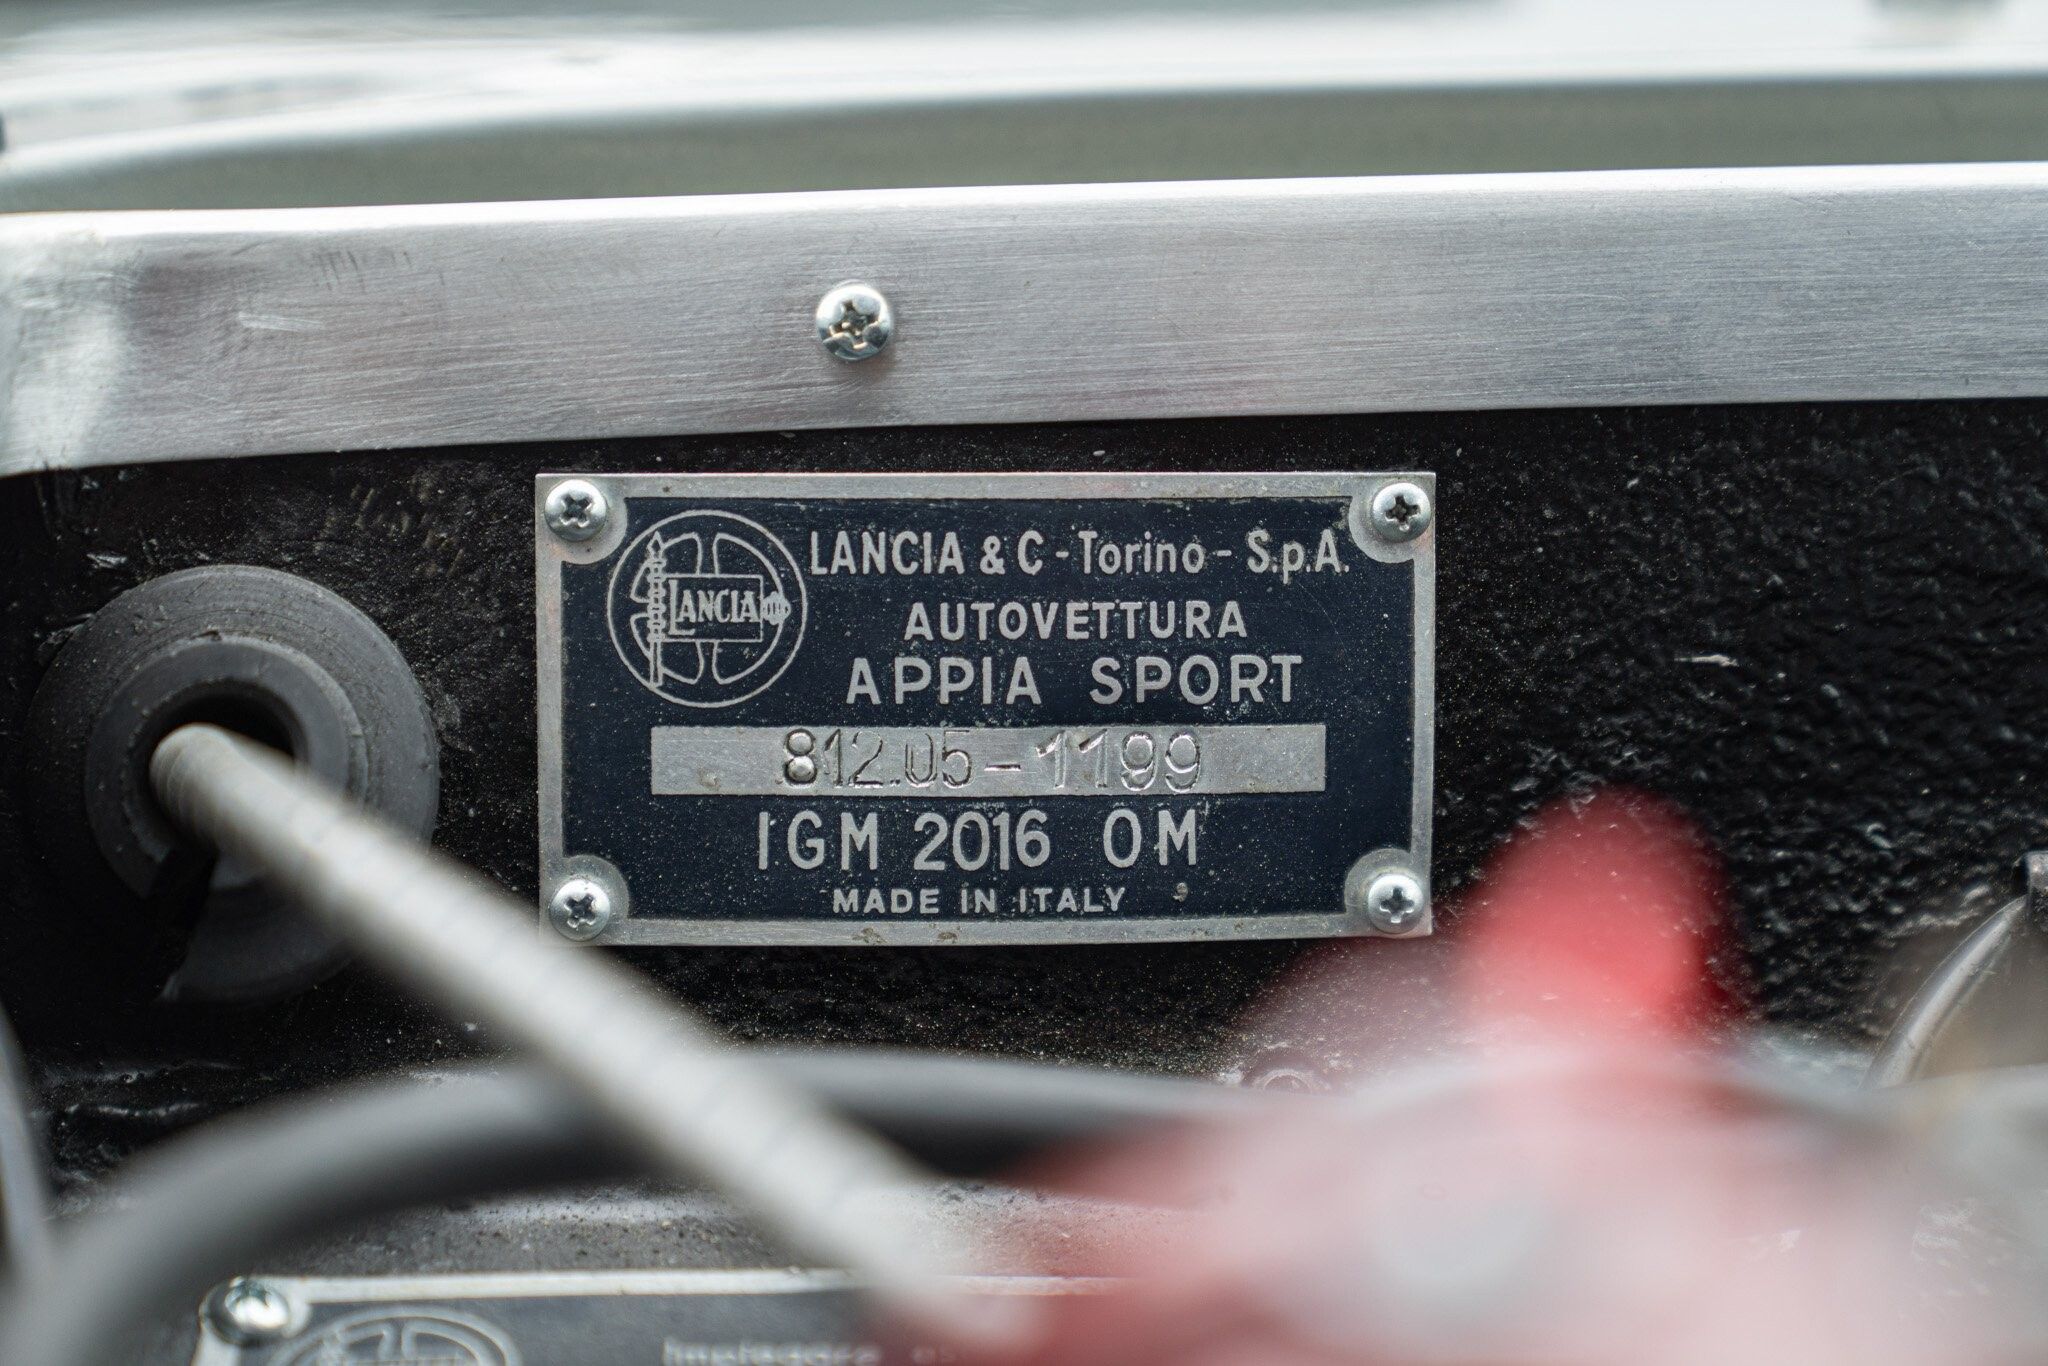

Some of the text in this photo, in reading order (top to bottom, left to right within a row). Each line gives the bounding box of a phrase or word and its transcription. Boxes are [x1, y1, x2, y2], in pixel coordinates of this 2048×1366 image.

[811, 530, 965, 575] LANCIA
[979, 535, 1005, 575] &
[1246, 528, 1350, 584] S.p.A.
[668, 578, 760, 636] LANCIA
[904, 599, 1248, 641] AUTOVETTURA
[846, 654, 1302, 705] APPIA SPORT
[757, 810, 879, 872] IGM
[913, 810, 1052, 872] 2016
[832, 886, 1126, 914] MADE IN ITALY
